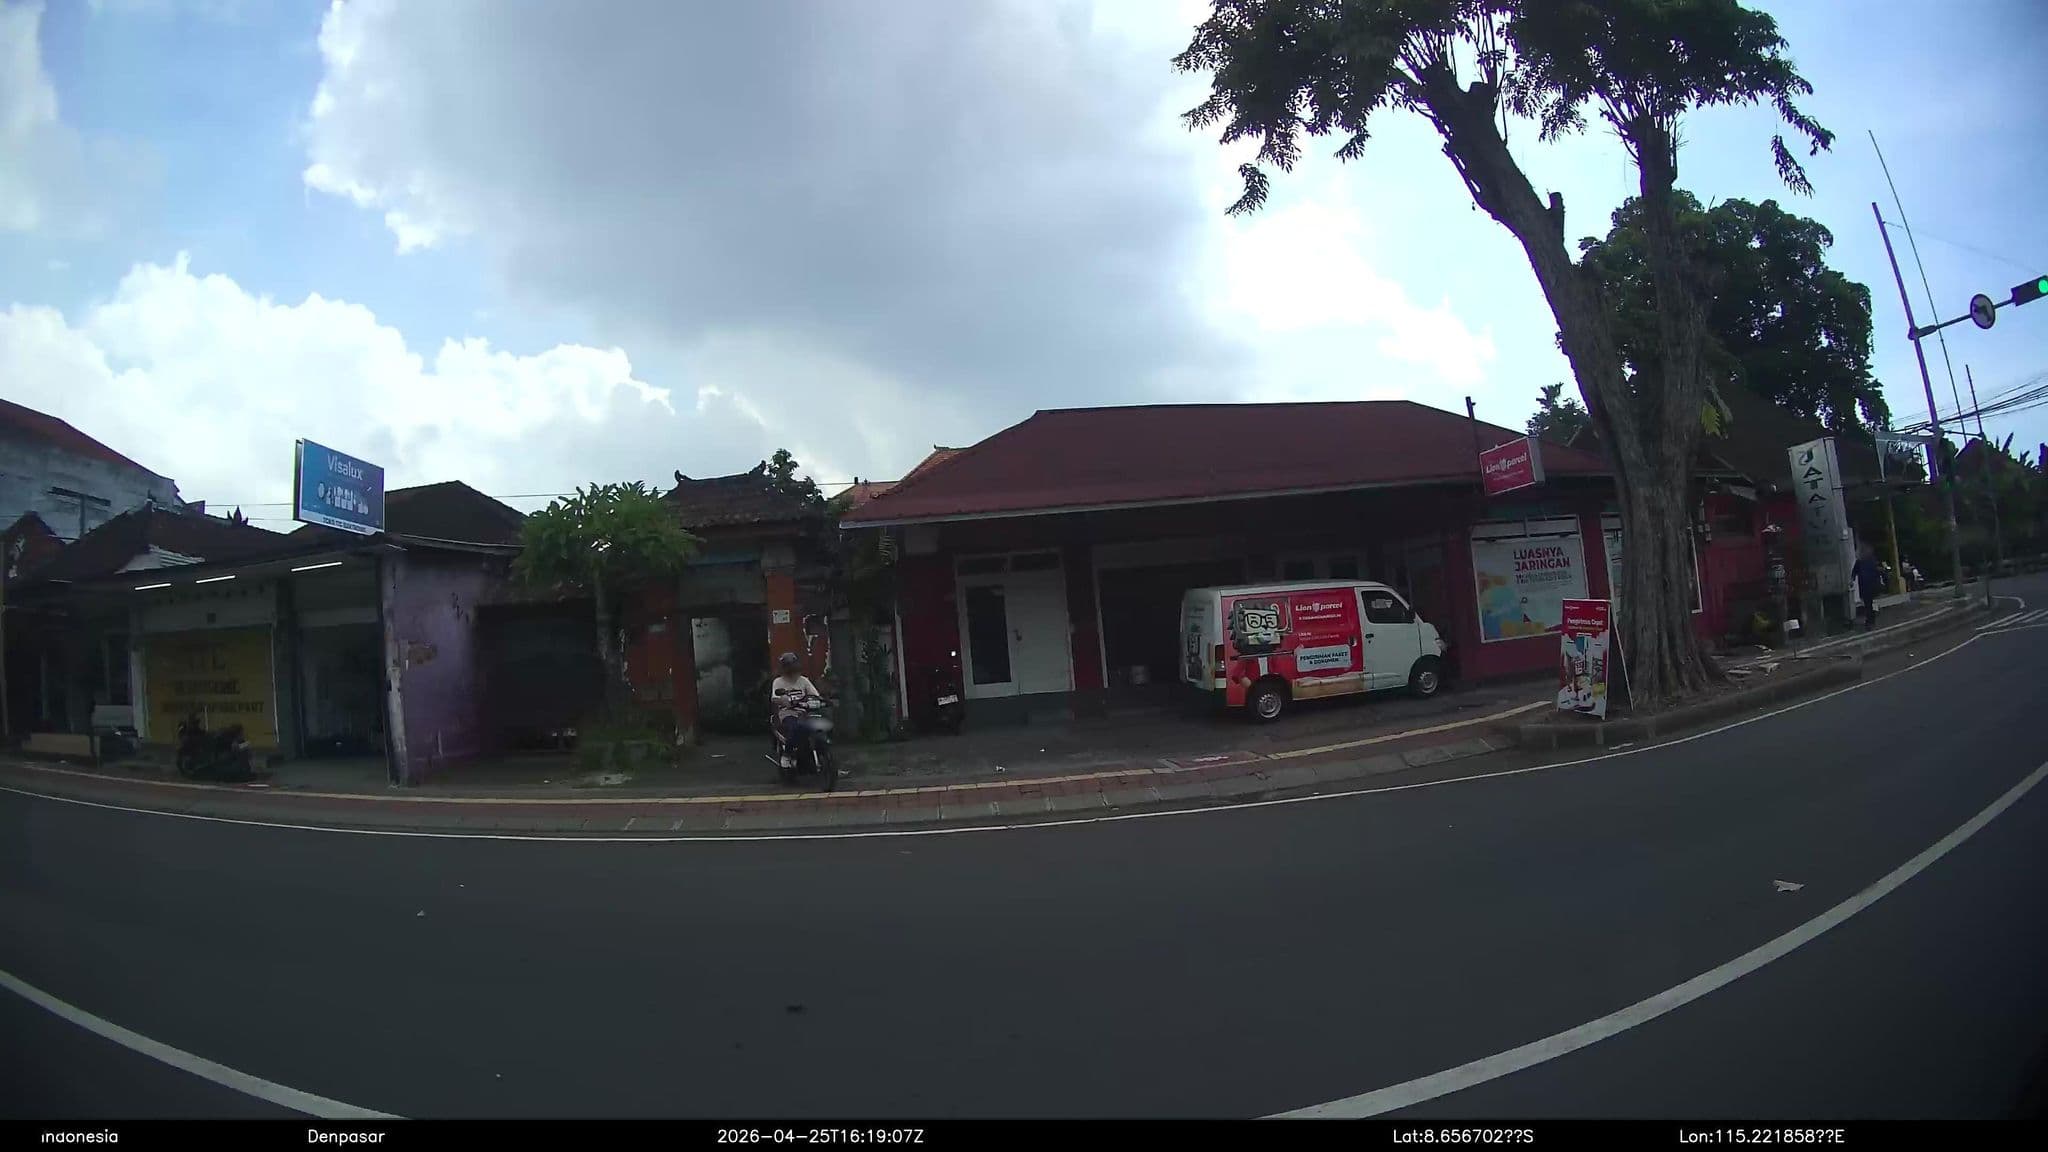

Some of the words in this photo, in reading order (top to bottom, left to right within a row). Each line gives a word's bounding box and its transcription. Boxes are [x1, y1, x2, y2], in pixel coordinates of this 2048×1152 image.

[327, 455, 364, 480] Visalux
[1486, 462, 1500, 474] Lion
[1506, 452, 1527, 470] parcel
[1513, 546, 1564, 560] LUASNYA
[1514, 557, 1570, 571] JARINGAN
[1320, 602, 1343, 611] parcel
